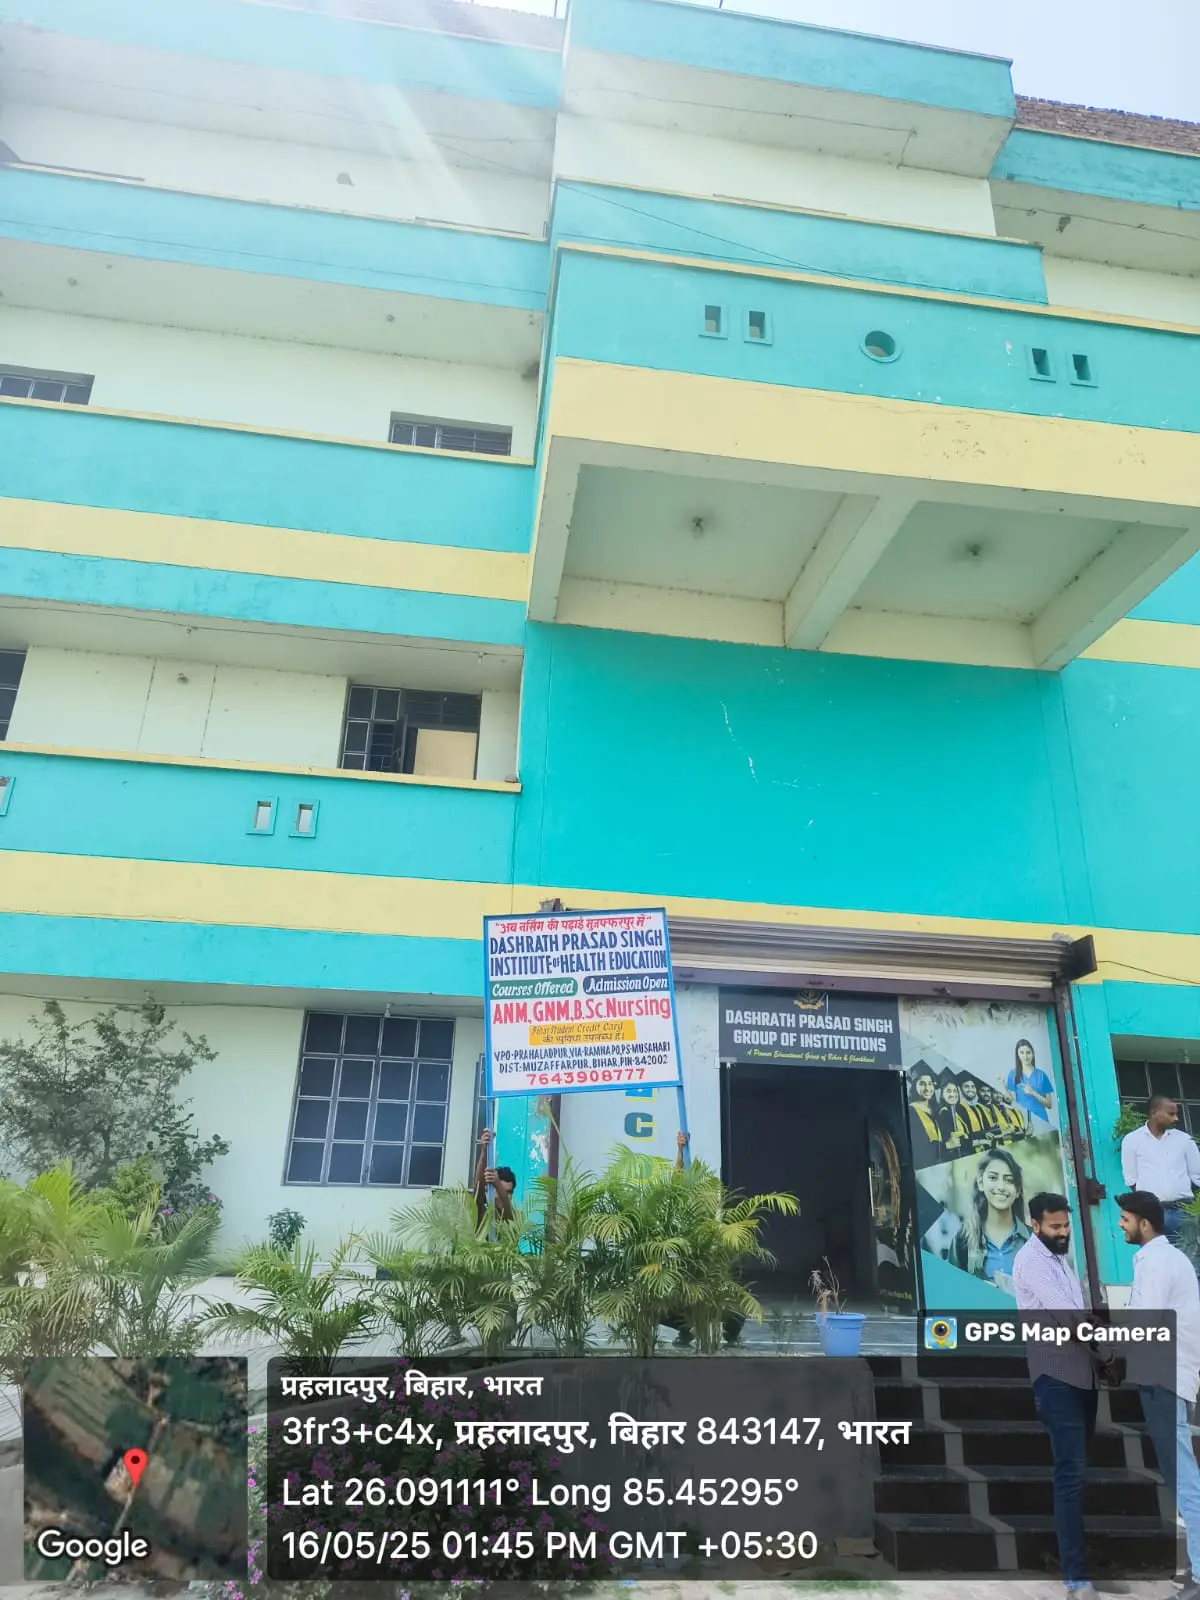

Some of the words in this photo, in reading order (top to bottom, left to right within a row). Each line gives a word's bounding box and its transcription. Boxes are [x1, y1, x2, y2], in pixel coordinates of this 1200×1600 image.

[547, 919, 558, 931] की
[490, 934, 558, 954] DASHRATH
[562, 931, 618, 951] PRASAD
[621, 929, 663, 948] SINGH
[490, 955, 552, 976] INSTITUTE
[560, 952, 606, 973] HEALTH
[610, 950, 668, 970] EDUCATION
[492, 982, 533, 997] Courses
[534, 980, 574, 996] Offered
[586, 976, 641, 993] Admission
[642, 976, 668, 991] Open
[577, 1022, 600, 1032] Credit
[603, 1022, 624, 1032] Card
[726, 1008, 796, 1028] DASHRATH
[799, 1013, 851, 1031] PRASAD
[854, 1017, 894, 1034] SINGH
[734, 1029, 778, 1046] GROUP
[780, 1032, 797, 1047] OF
[800, 1033, 887, 1052] INSTITUTIONS
[526, 1068, 646, 1086] 7643908777
